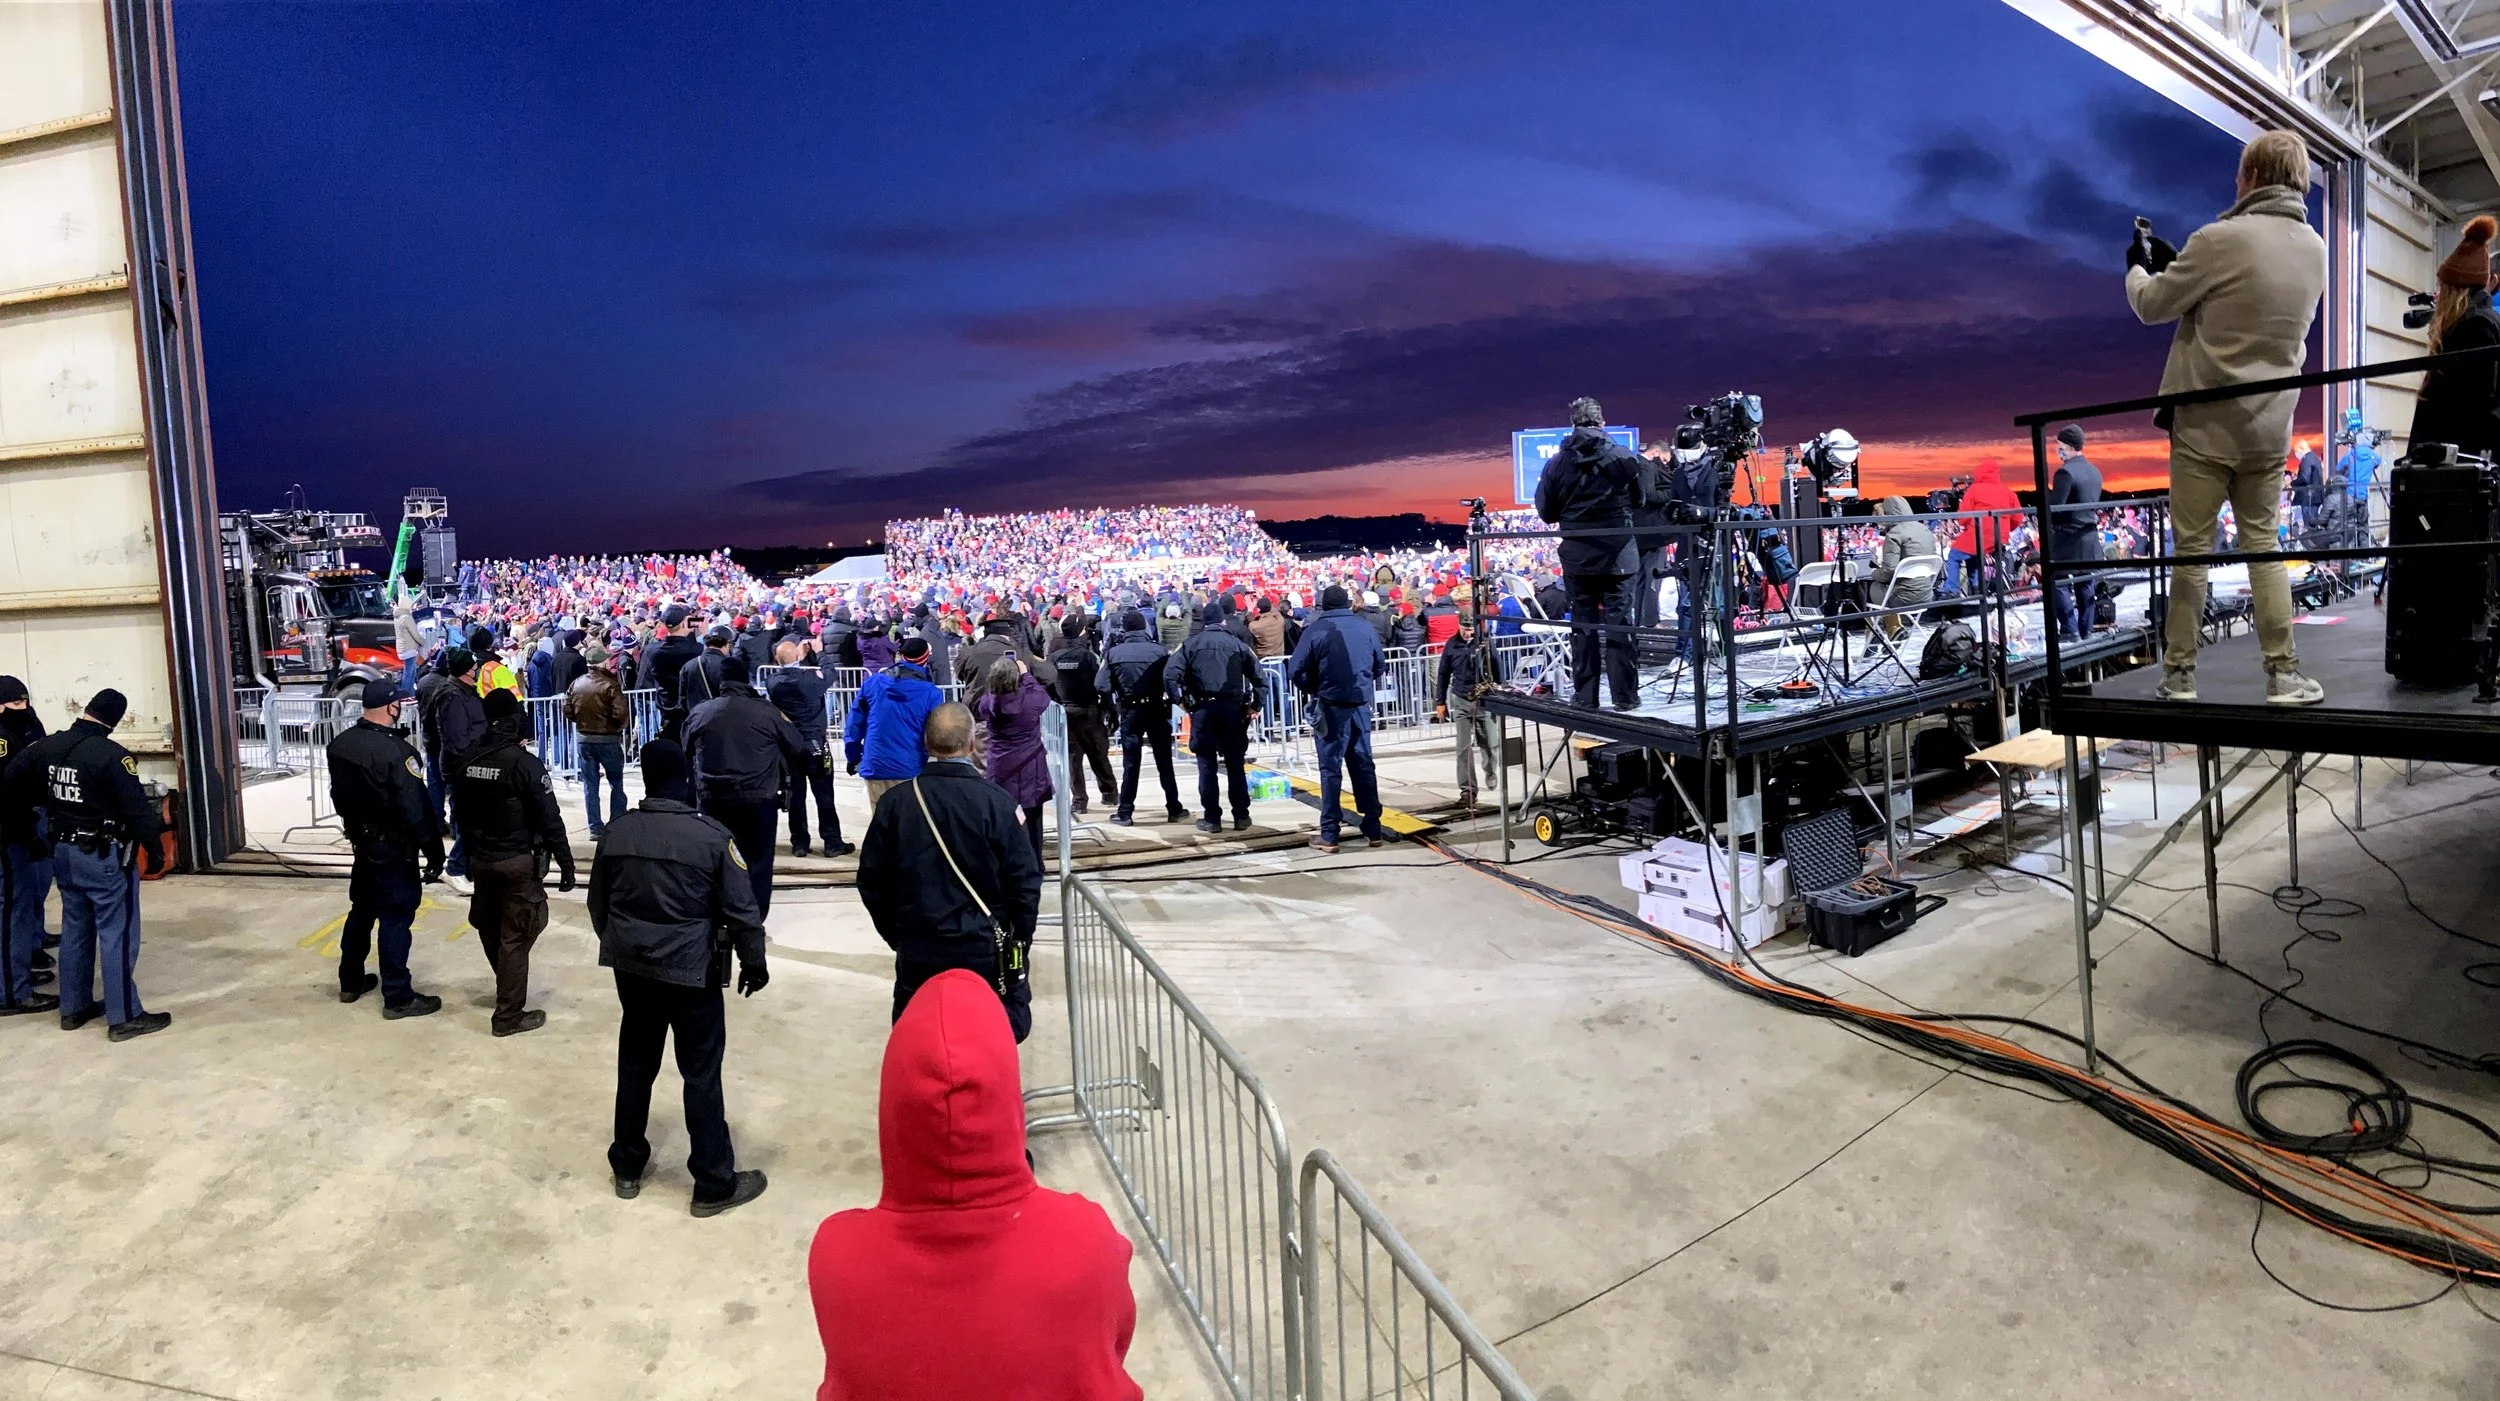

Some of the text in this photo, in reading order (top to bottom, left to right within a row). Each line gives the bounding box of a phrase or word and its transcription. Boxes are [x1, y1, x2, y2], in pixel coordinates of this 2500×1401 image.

[48, 765, 79, 785] STATE
[466, 765, 501, 780] SHERIFF
[48, 782, 84, 803] OLICE
